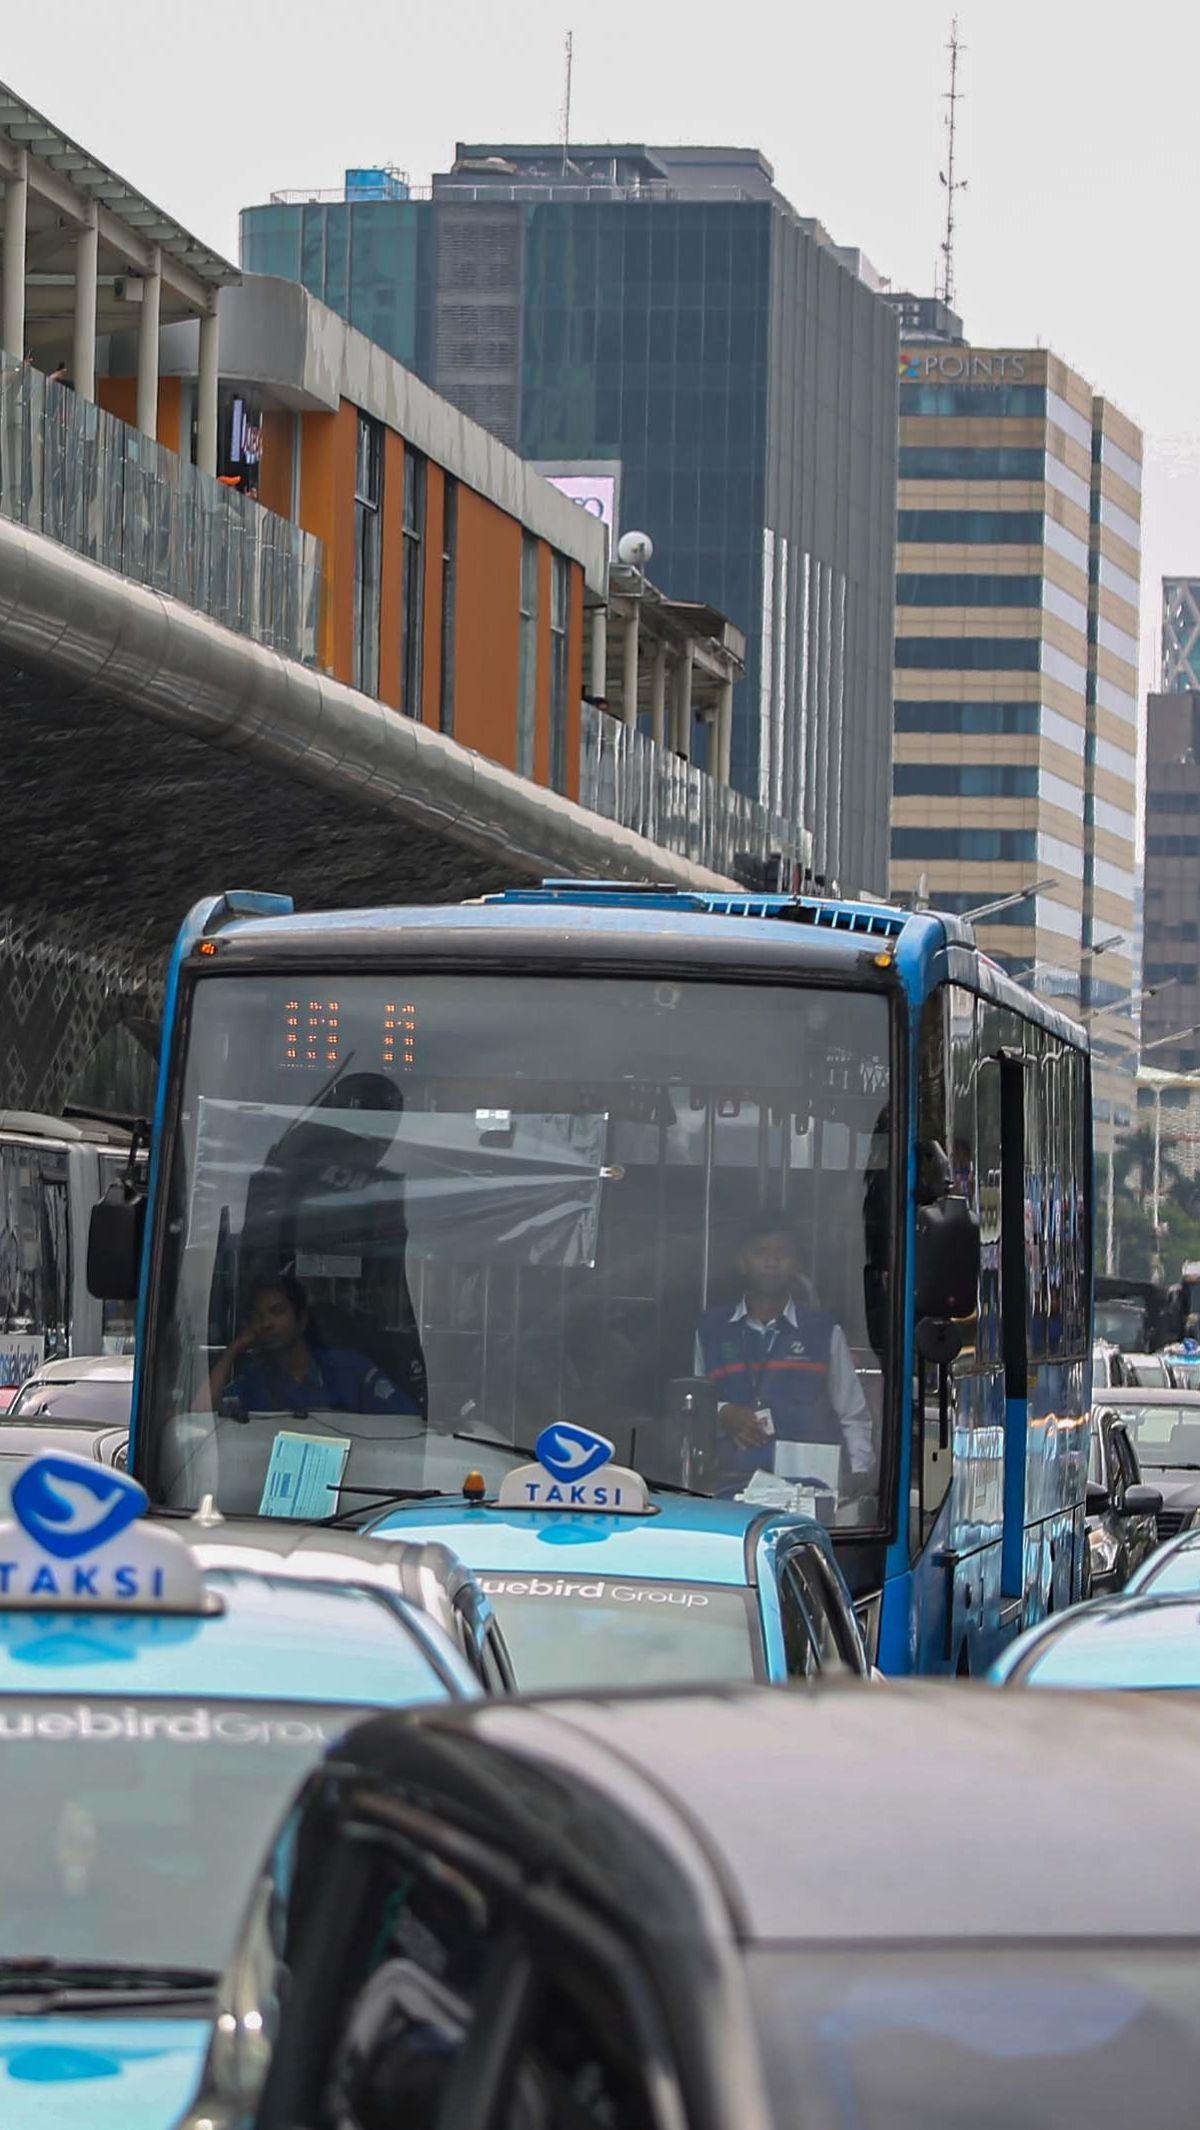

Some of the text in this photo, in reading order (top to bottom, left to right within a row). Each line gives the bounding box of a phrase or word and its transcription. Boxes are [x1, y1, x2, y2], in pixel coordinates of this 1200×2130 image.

[925, 354, 1025, 379] POINTS
[525, 1483, 622, 1506] TAKSI
[0, 1562, 164, 1598] TAKSI
[611, 1585, 709, 1608] Group
